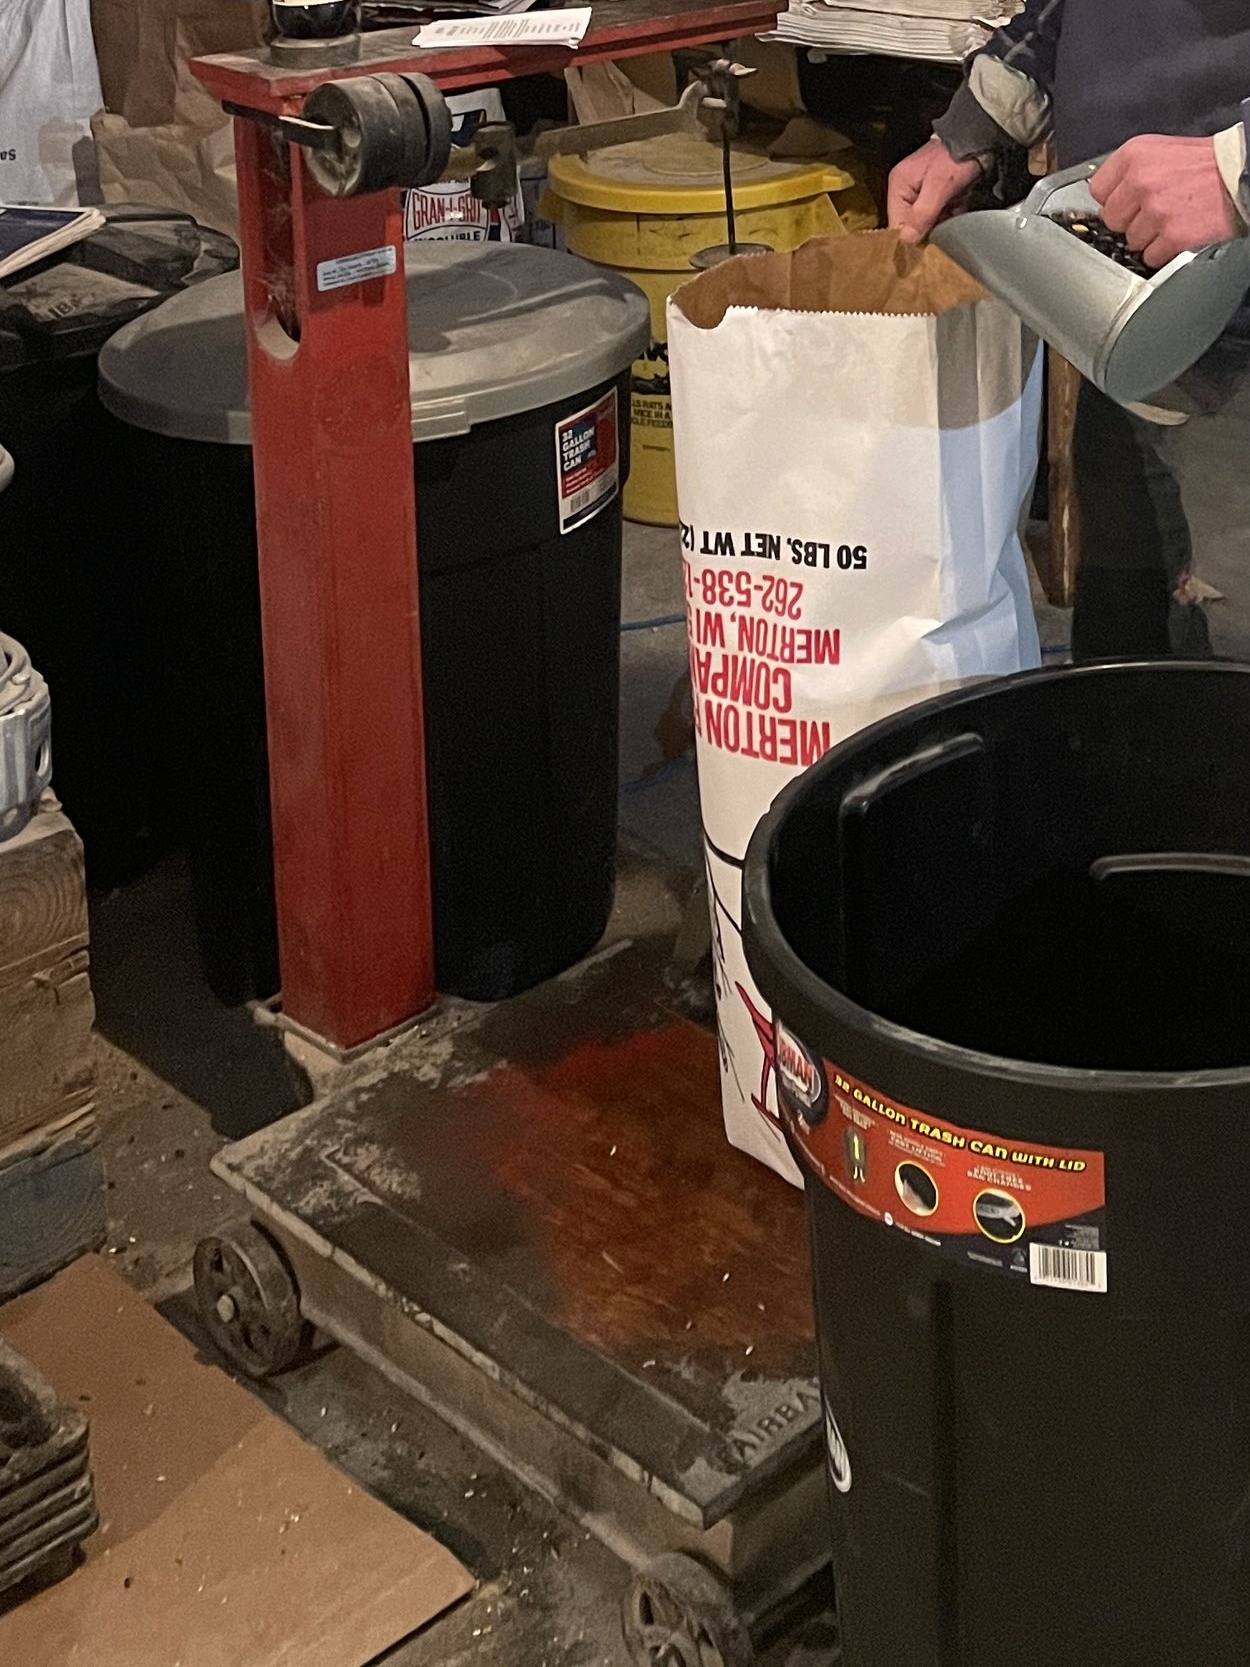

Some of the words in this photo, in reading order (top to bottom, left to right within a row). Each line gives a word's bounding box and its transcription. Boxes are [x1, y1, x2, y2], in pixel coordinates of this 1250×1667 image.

[562, 429, 573, 443] 32
[562, 426, 596, 452] GALLON
[562, 440, 592, 462] TRASH
[563, 455, 582, 472] CAN
[700, 530, 736, 557] WT
[741, 533, 781, 561] NET
[837, 544, 868, 570] 50
[682, 561, 804, 621] 262-538-1
[728, 609, 841, 666] MERTON,
[693, 646, 792, 714] COMPA
[705, 701, 831, 768] MERTON
[853, 1088, 907, 1126] GALLON
[910, 1119, 966, 1149] TRASH
[970, 1138, 1008, 1161] CAN
[1011, 1151, 1055, 1171] WITH
[1058, 1159, 1088, 1173] LID
